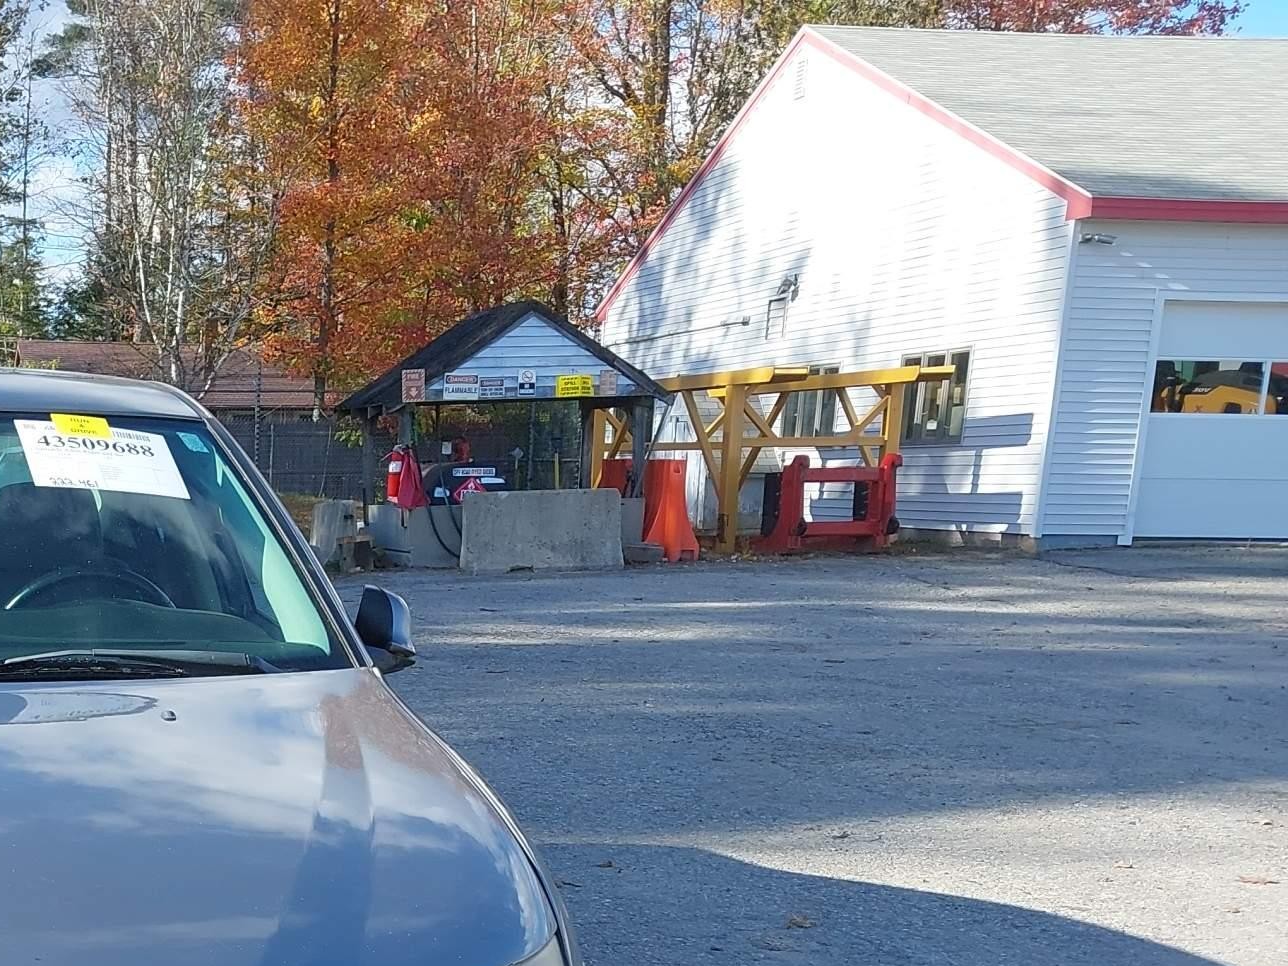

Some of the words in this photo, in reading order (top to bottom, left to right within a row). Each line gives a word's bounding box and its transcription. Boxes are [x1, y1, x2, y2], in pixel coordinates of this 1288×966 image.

[449, 375, 475, 383] DANGER
[445, 386, 477, 394] FLAMMABLE
[37, 435, 155, 458] 43509688
